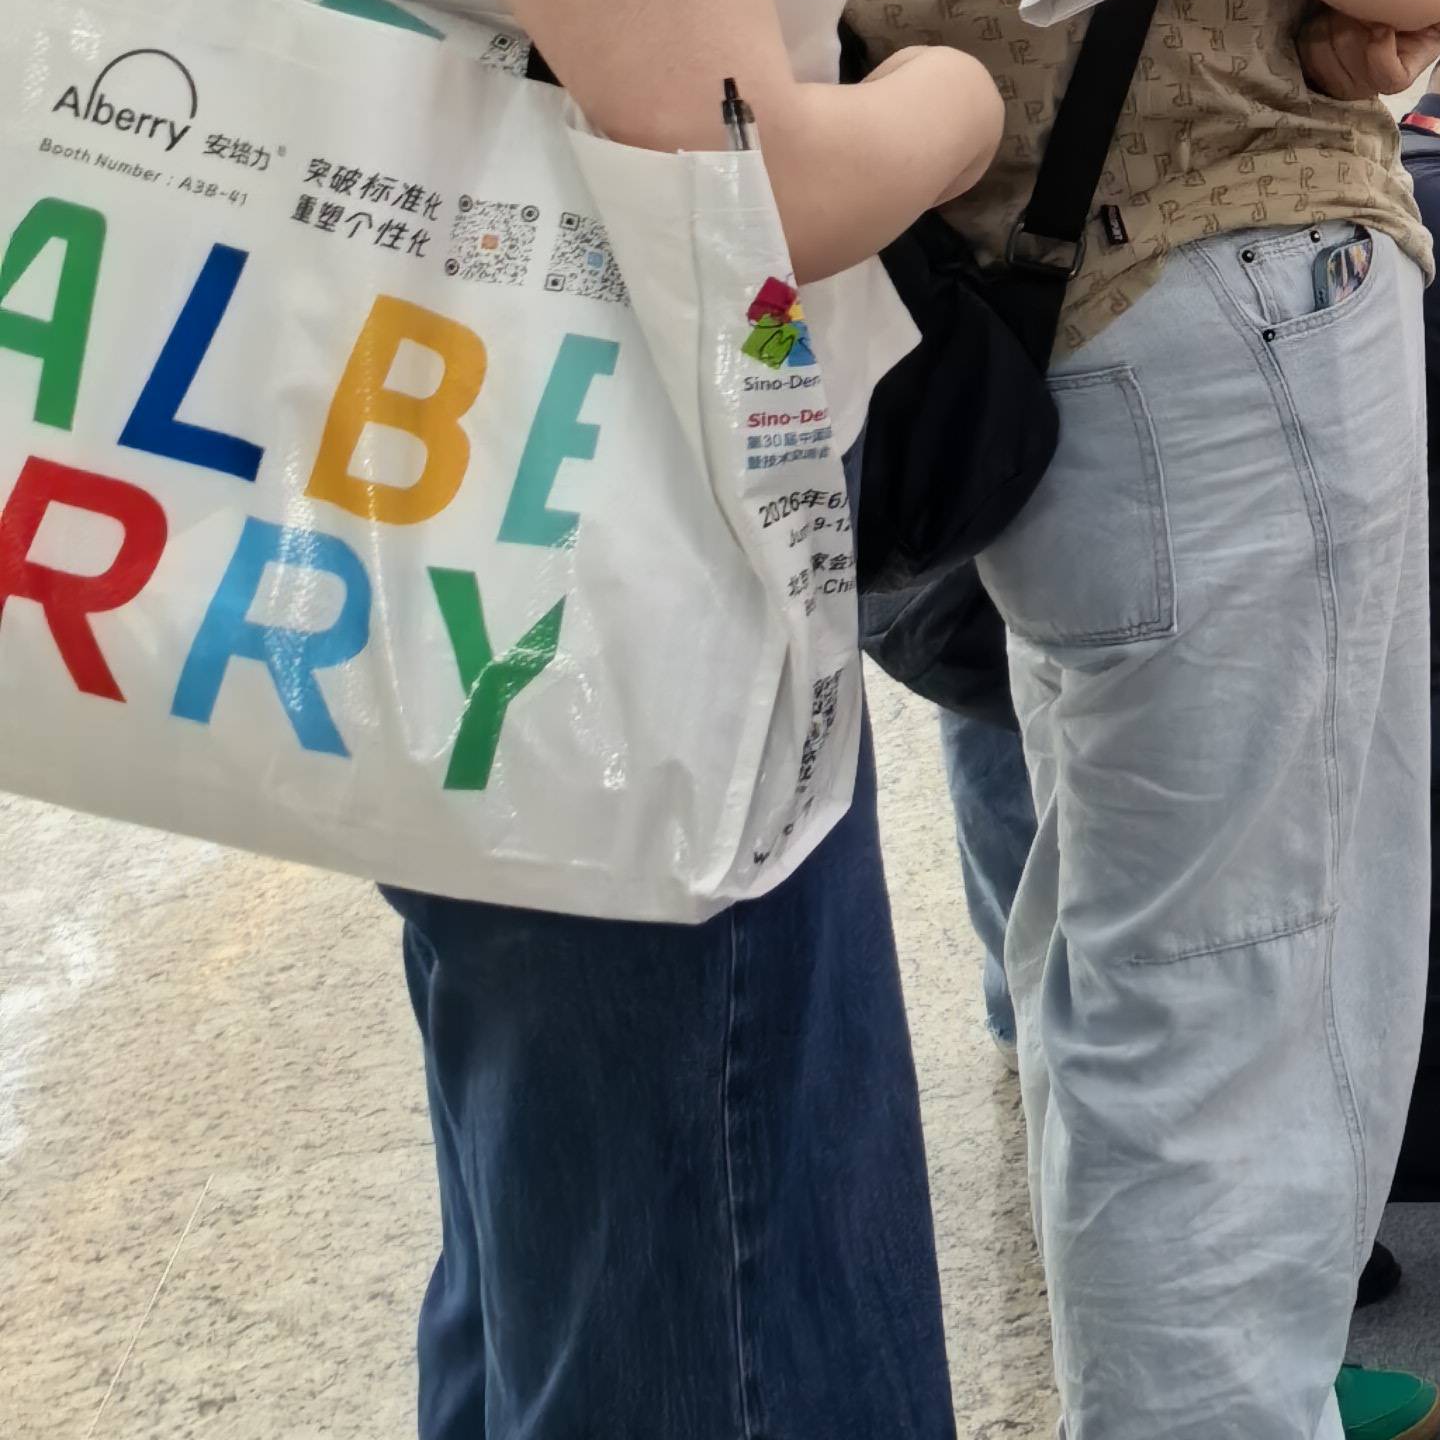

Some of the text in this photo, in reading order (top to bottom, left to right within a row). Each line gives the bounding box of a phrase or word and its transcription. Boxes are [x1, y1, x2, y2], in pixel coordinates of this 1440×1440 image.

[39, 137, 90, 164] Booth
[94, 152, 161, 183] Number
[302, 157, 446, 221] 突破标准化
[290, 193, 435, 258] 重塑个性化
[758, 488, 848, 529] 2026年6
